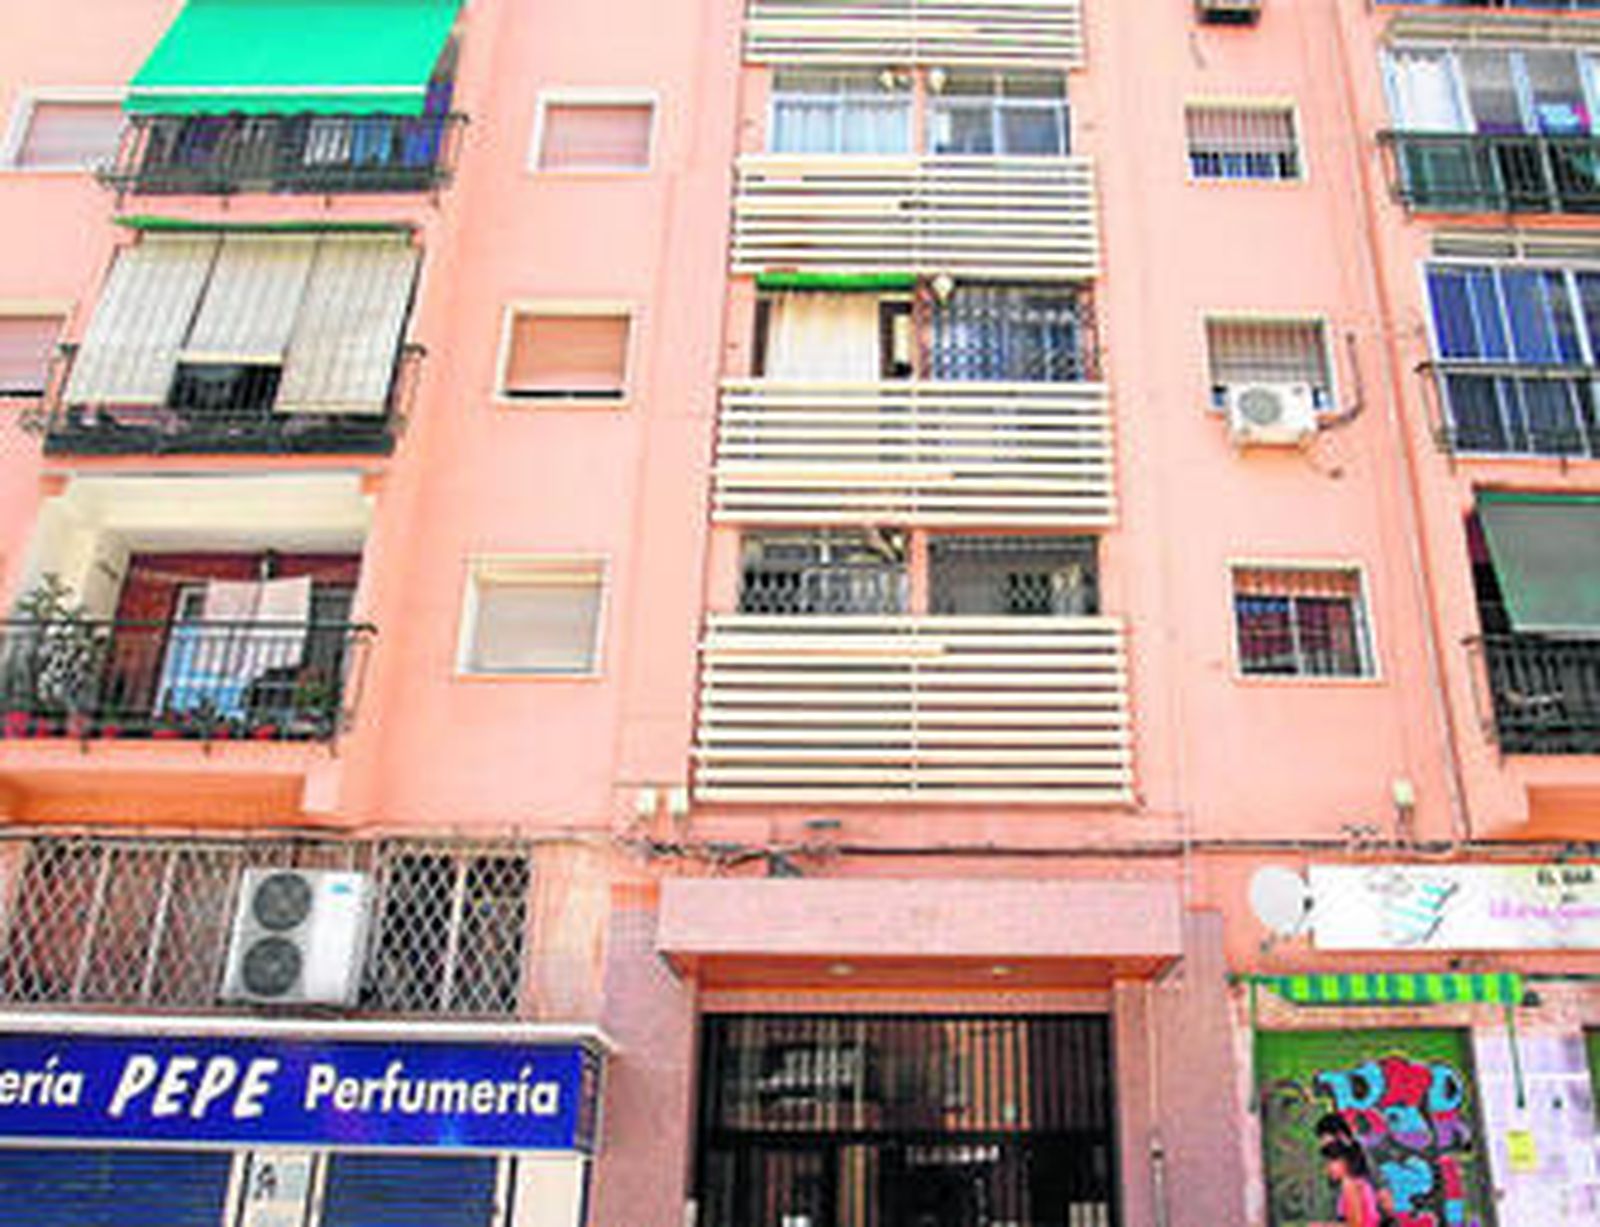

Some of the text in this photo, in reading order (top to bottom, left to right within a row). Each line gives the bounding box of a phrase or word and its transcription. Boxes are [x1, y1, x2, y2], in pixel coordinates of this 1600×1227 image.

[0, 1055, 560, 1118] ería PEPE Perfumería
